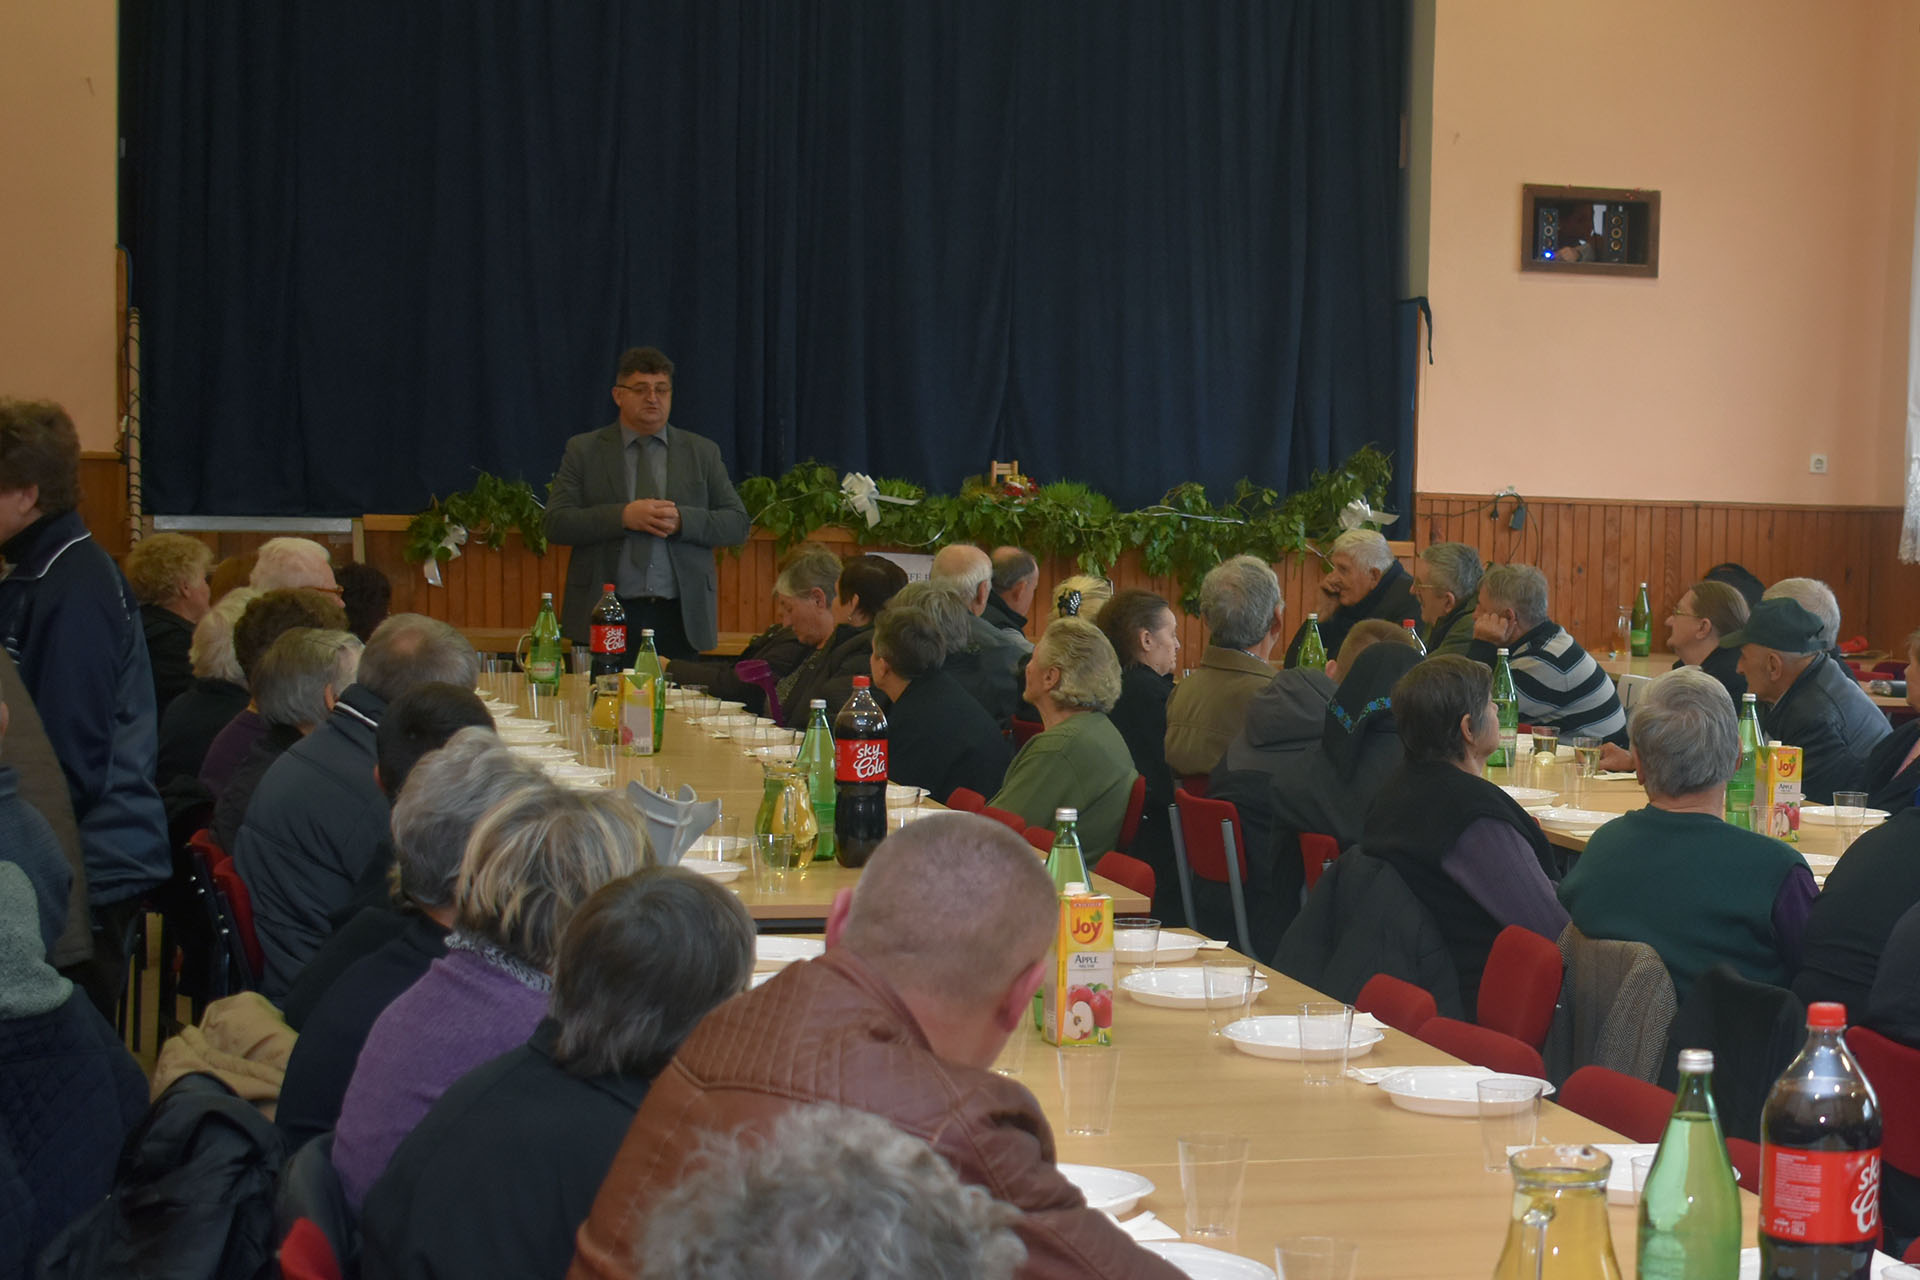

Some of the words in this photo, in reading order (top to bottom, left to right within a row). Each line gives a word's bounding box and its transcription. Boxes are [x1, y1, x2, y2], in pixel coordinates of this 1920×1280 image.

[603, 637, 625, 651] Cola
[857, 743, 884, 760] sky
[853, 757, 886, 778] Cola
[1778, 760, 1797, 777] Joy
[1073, 917, 1103, 945] Joy
[1858, 1155, 1880, 1191] sk
